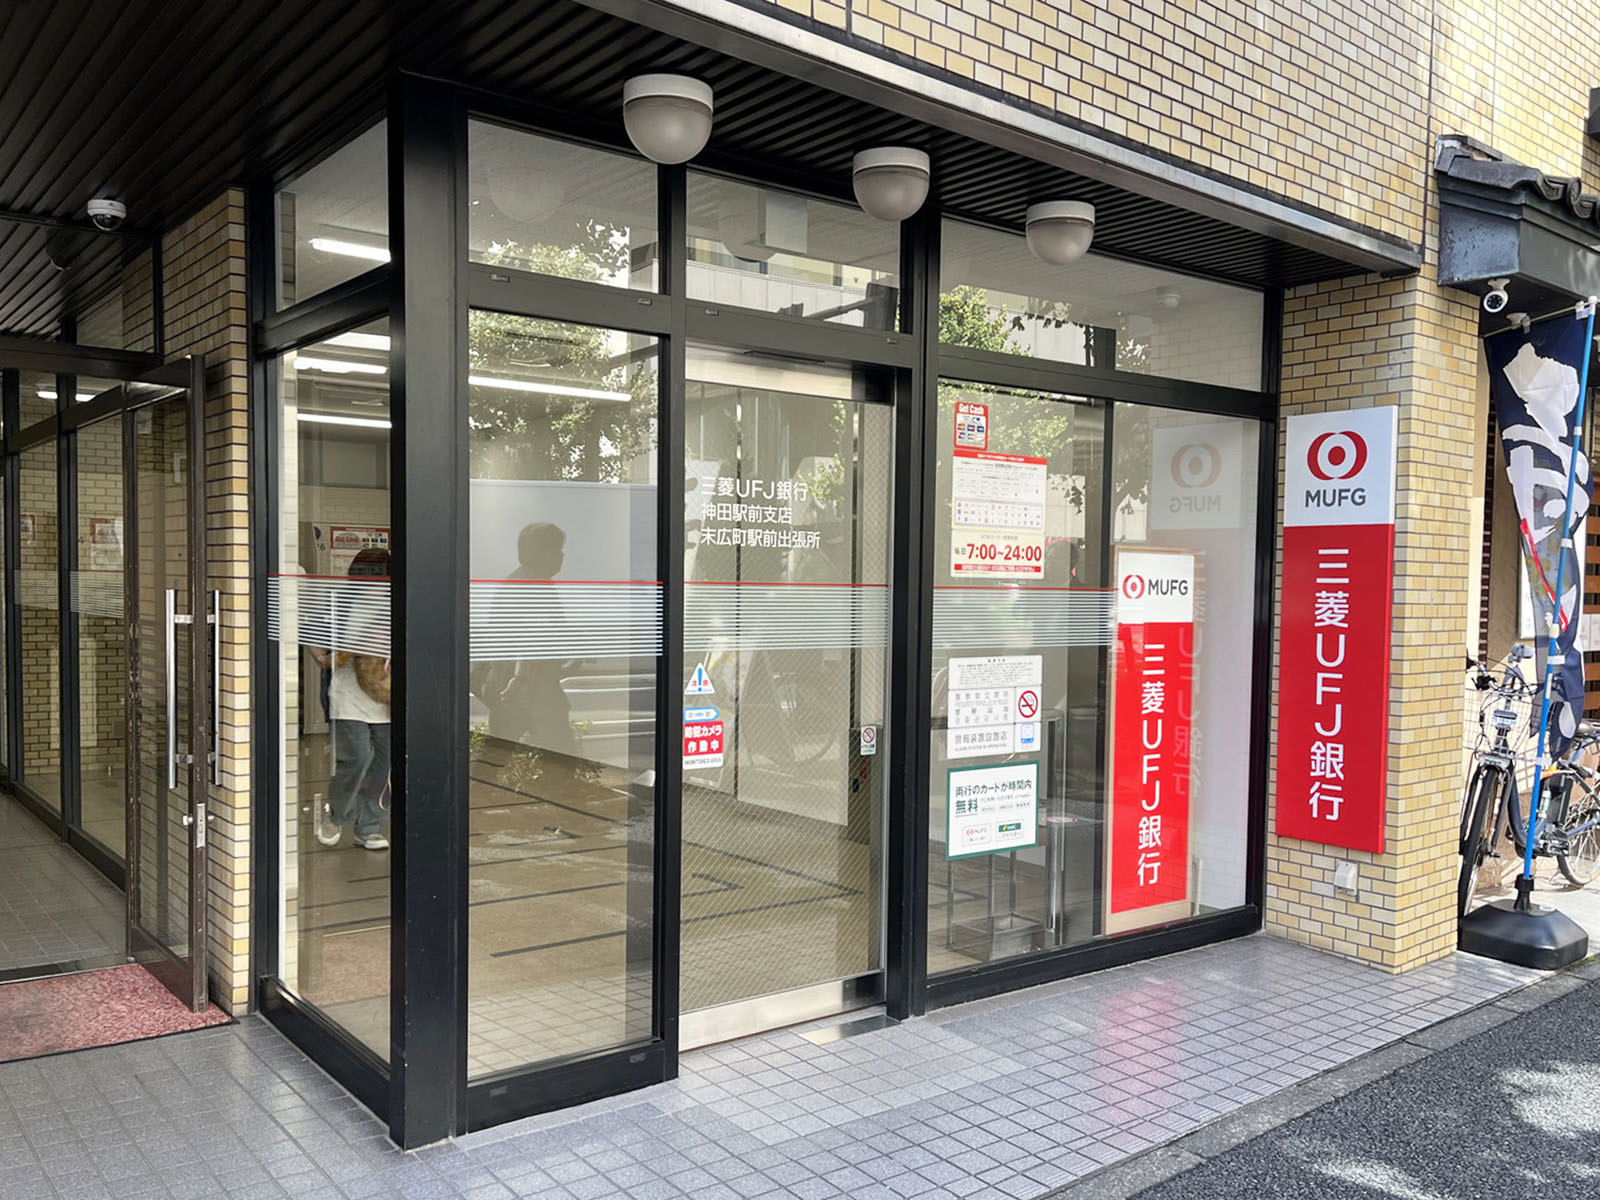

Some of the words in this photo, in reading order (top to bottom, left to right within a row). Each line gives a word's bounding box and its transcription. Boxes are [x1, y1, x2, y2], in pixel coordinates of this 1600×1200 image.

[701, 476, 808, 500] 三菱UFJ銀行
[1305, 488, 1366, 508] MUFG
[701, 502, 792, 524] 神田駅前支店
[701, 527, 821, 549] 末広町駅前出張所
[1148, 579, 1188, 596] MUFG
[1309, 549, 1350, 821] 三菱UFJ銀行
[1137, 644, 1165, 886] 三菱UFJ銀行
[955, 779, 1032, 798] 両行のカードが時間内
[955, 798, 978, 815] 無料
